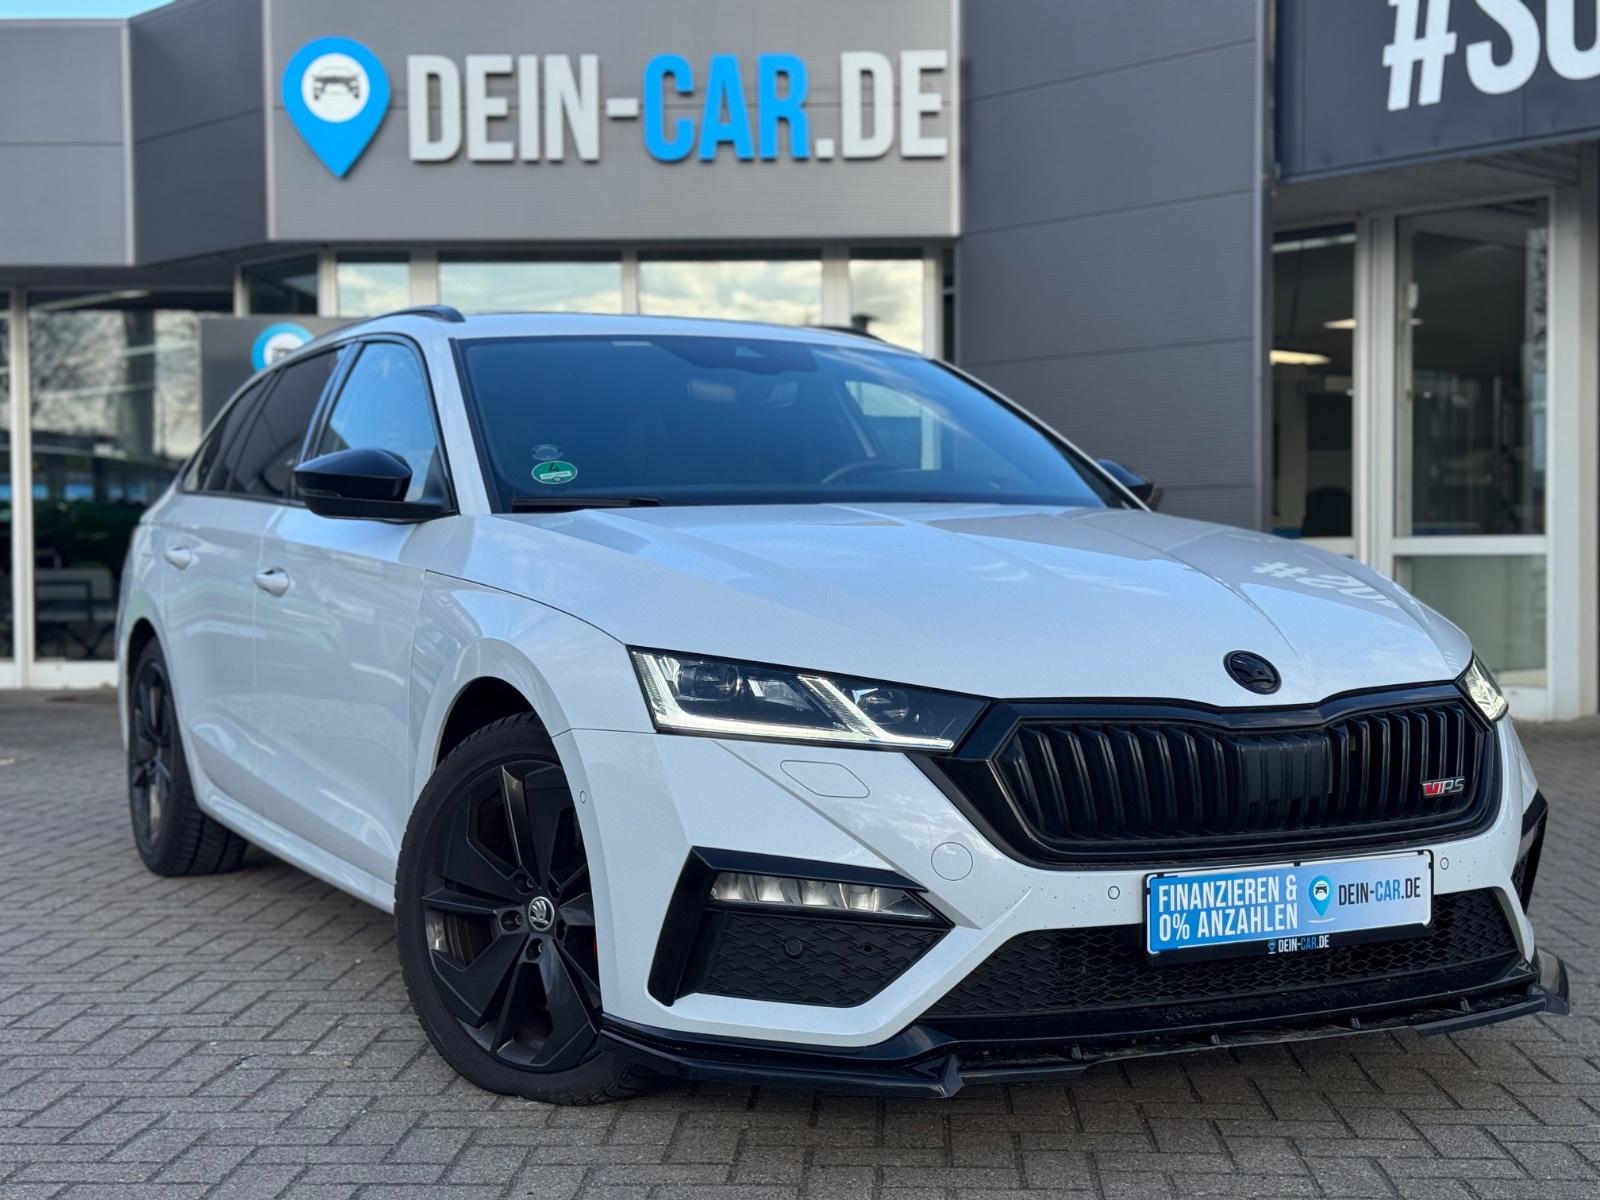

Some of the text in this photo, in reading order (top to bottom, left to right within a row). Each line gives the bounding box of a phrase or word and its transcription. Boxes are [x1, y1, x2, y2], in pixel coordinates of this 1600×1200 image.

[407, 49, 948, 163] DEIN-CAR.DE
[1158, 874, 1298, 912] FINANZIEREN &
[1338, 877, 1421, 906] DEIN-CAR.DE
[1159, 902, 1298, 942] 0% ANZAHLEN
[1278, 934, 1330, 953] DEIN-CAR.DE
